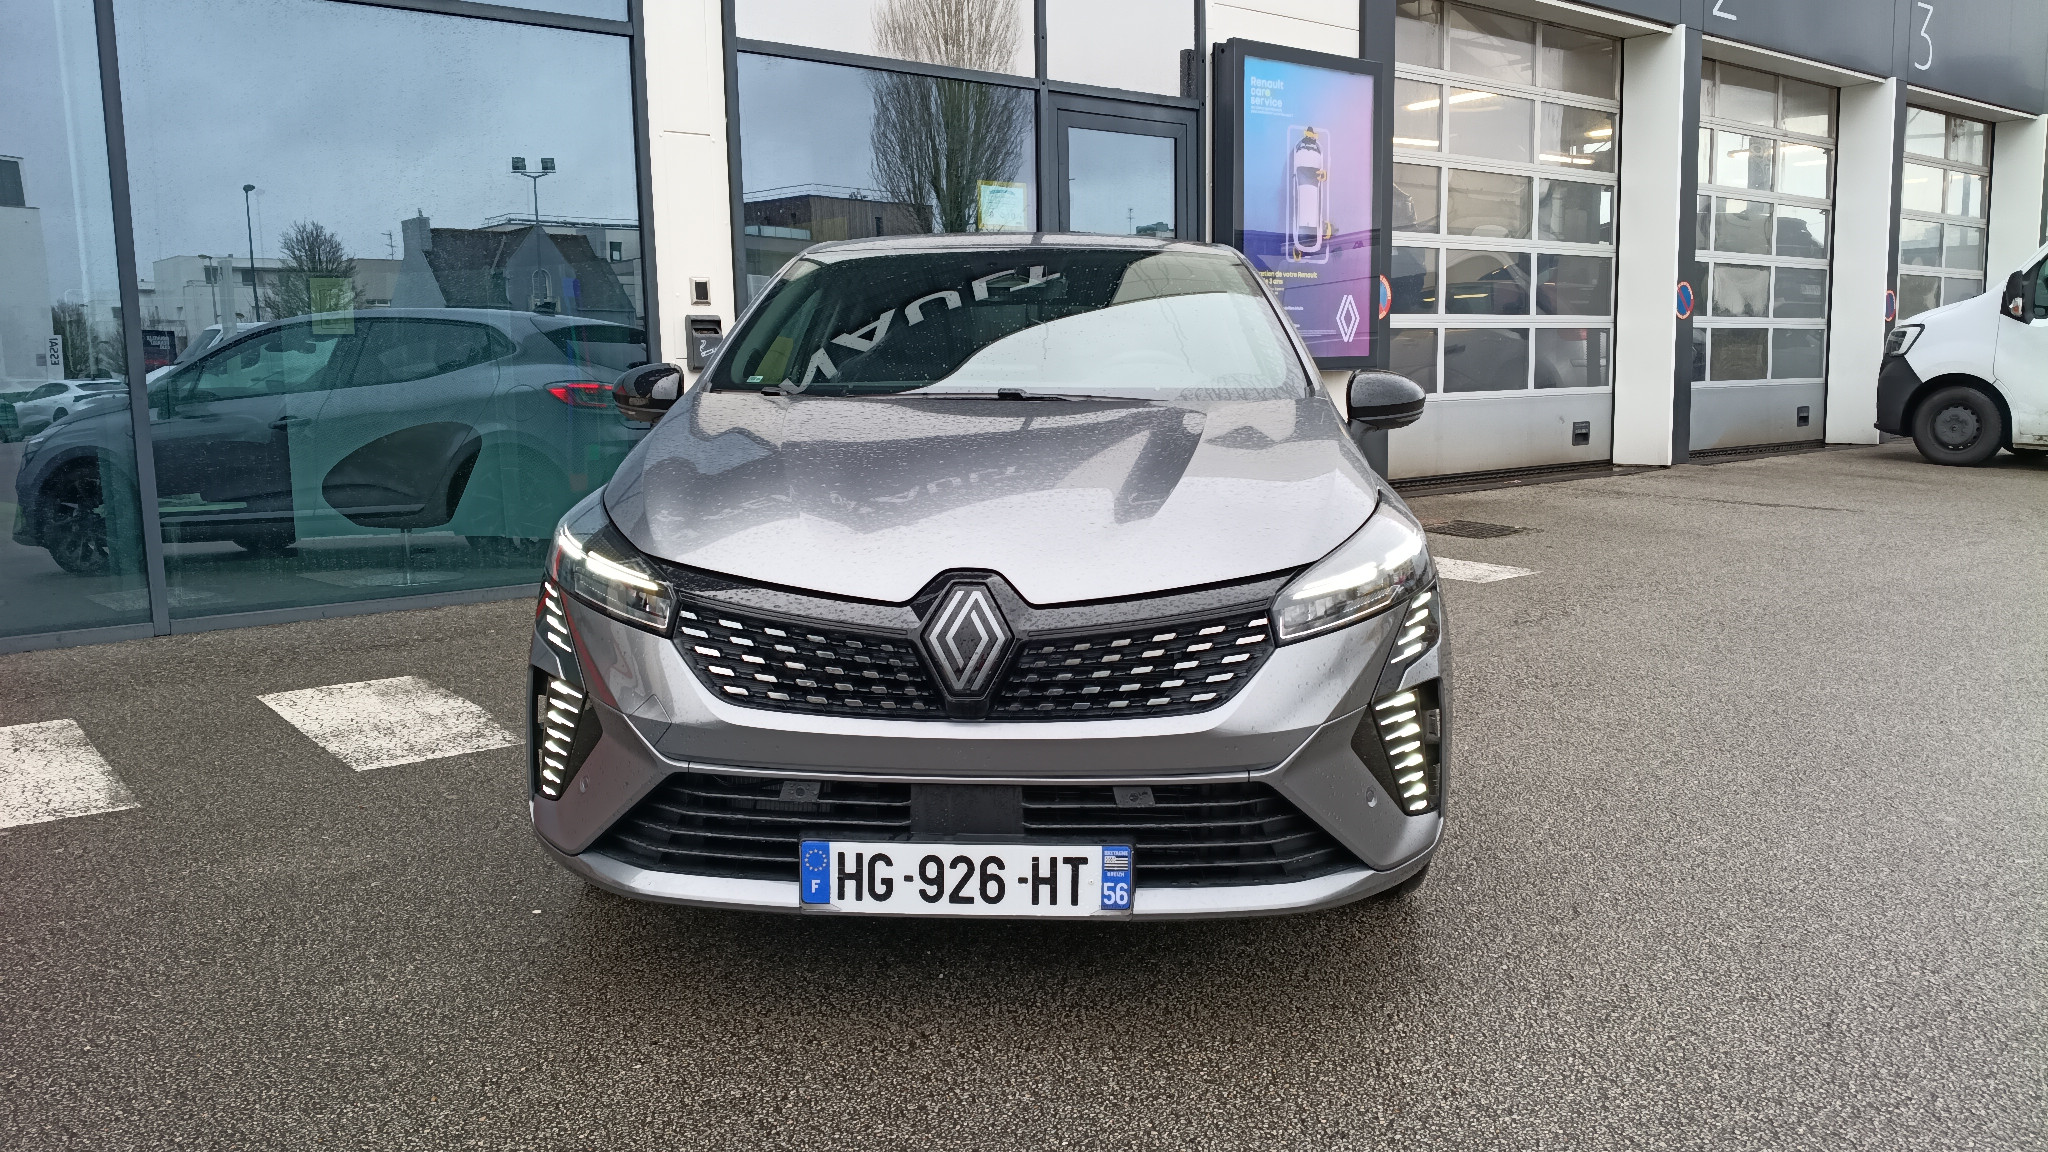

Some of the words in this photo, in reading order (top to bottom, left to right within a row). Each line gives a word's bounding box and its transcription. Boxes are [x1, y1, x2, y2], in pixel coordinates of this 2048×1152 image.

[1914, 2, 1934, 71] 3
[1250, 76, 1284, 90] Renault
[1250, 87, 1271, 97] care
[1250, 97, 1283, 108] service
[811, 879, 821, 894] F
[1103, 882, 1129, 905] 56
